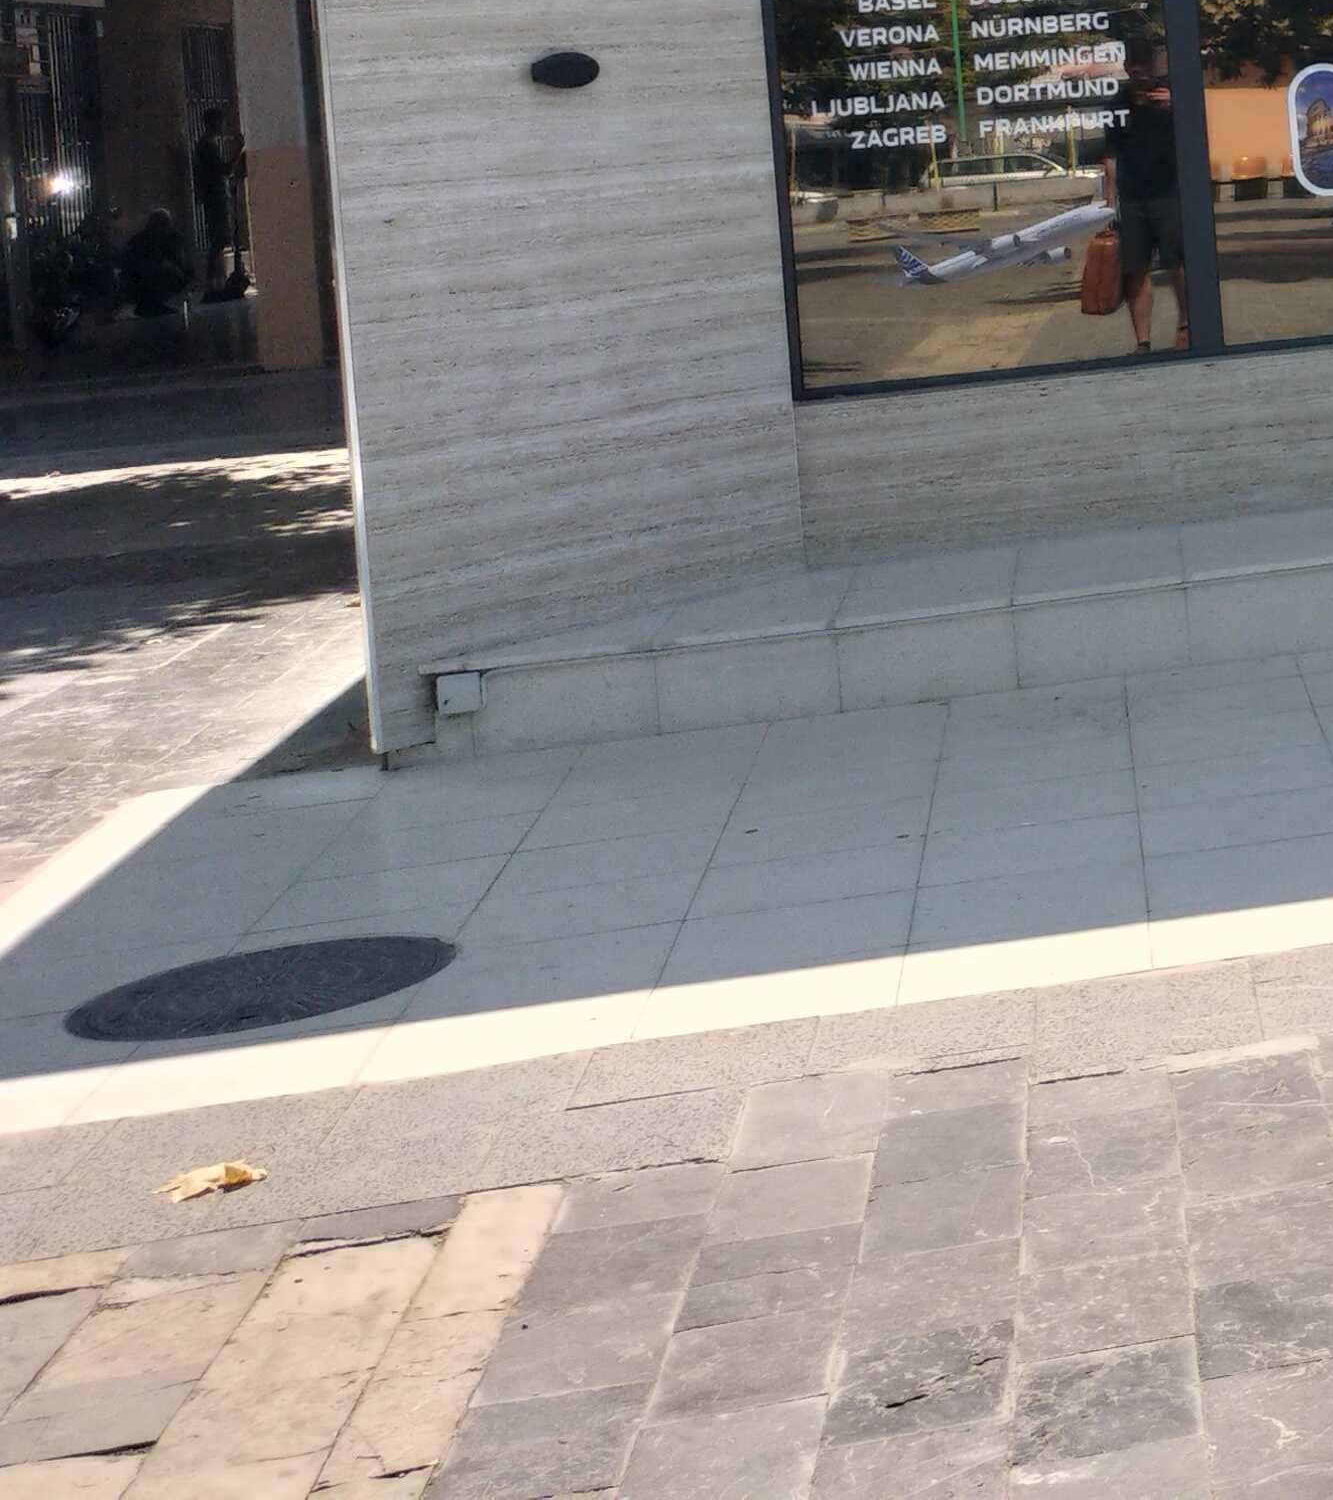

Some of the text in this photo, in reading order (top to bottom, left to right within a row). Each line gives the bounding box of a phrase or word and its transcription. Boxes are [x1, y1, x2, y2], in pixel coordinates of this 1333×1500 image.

[839, 25, 940, 48] VERONA
[971, 12, 1109, 39] NÜRNBERG
[849, 58, 942, 81] WIENNA
[974, 42, 1126, 71] MEMMINGEN
[812, 91, 945, 118] LJUBLJANA
[976, 77, 1119, 105] DORTMUND
[851, 125, 946, 149] ZAGREB
[978, 110, 1130, 139] FRANKFURT
